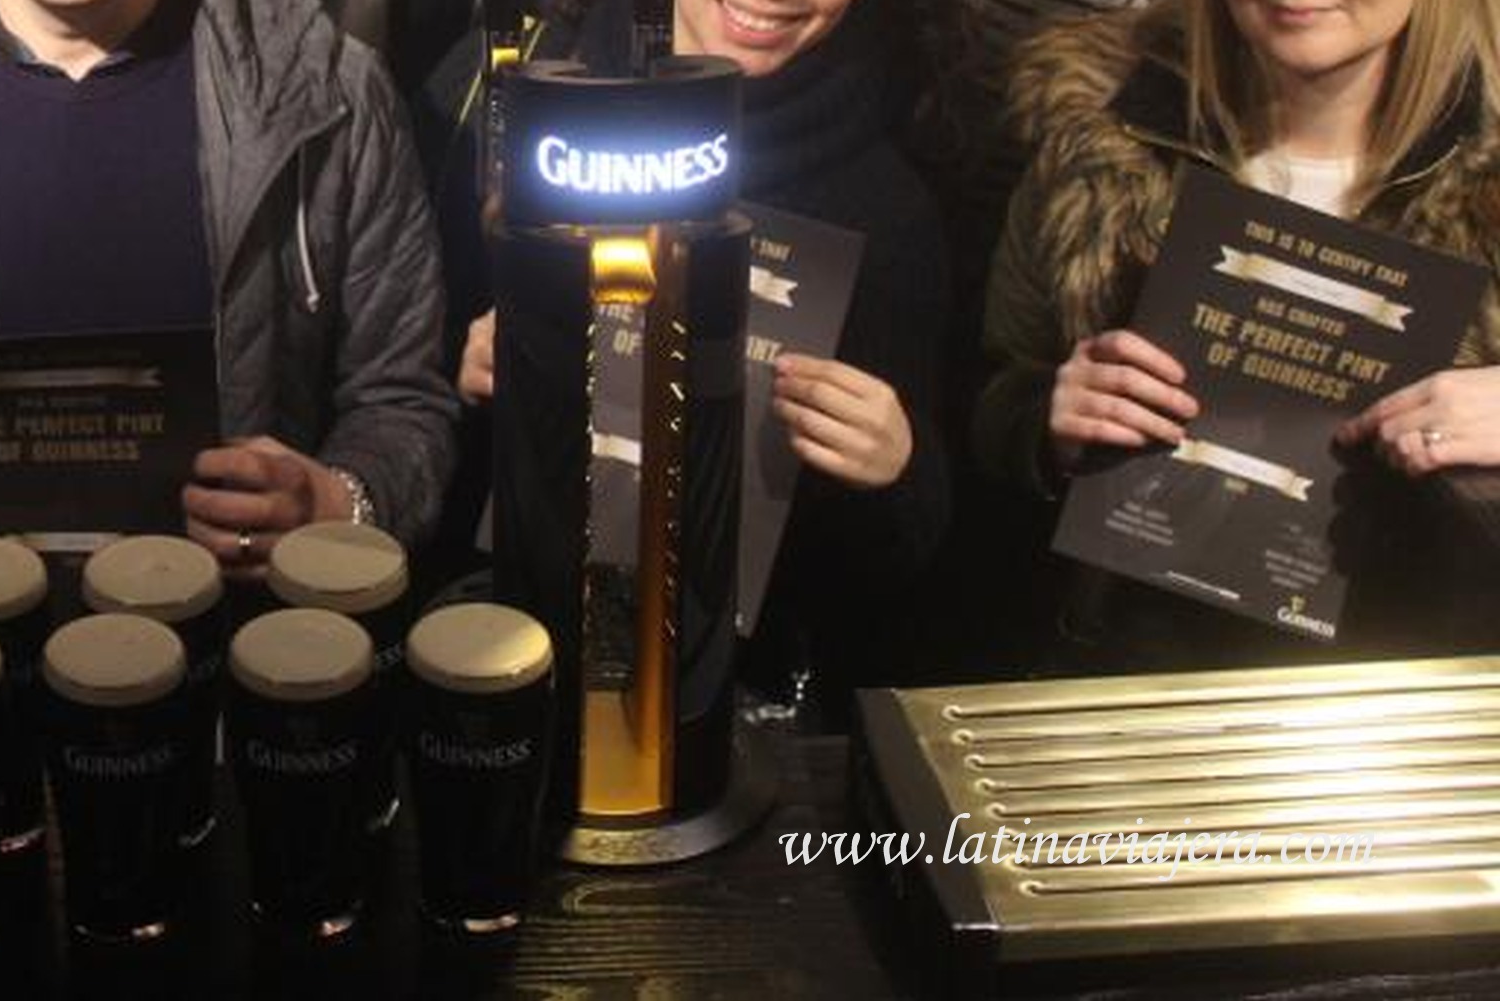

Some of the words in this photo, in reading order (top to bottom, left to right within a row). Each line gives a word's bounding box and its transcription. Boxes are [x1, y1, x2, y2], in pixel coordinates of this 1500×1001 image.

[536, 132, 729, 195] GUINNESS
[1244, 219, 1275, 245] THIS
[1318, 246, 1374, 277] CERTIFY
[746, 334, 782, 365] INT
[1193, 303, 1235, 337] THE
[1238, 319, 1335, 365] PERFECT
[1336, 350, 1390, 384] PINT
[1206, 342, 1239, 369] OF
[1242, 351, 1354, 401] GUINNESS
